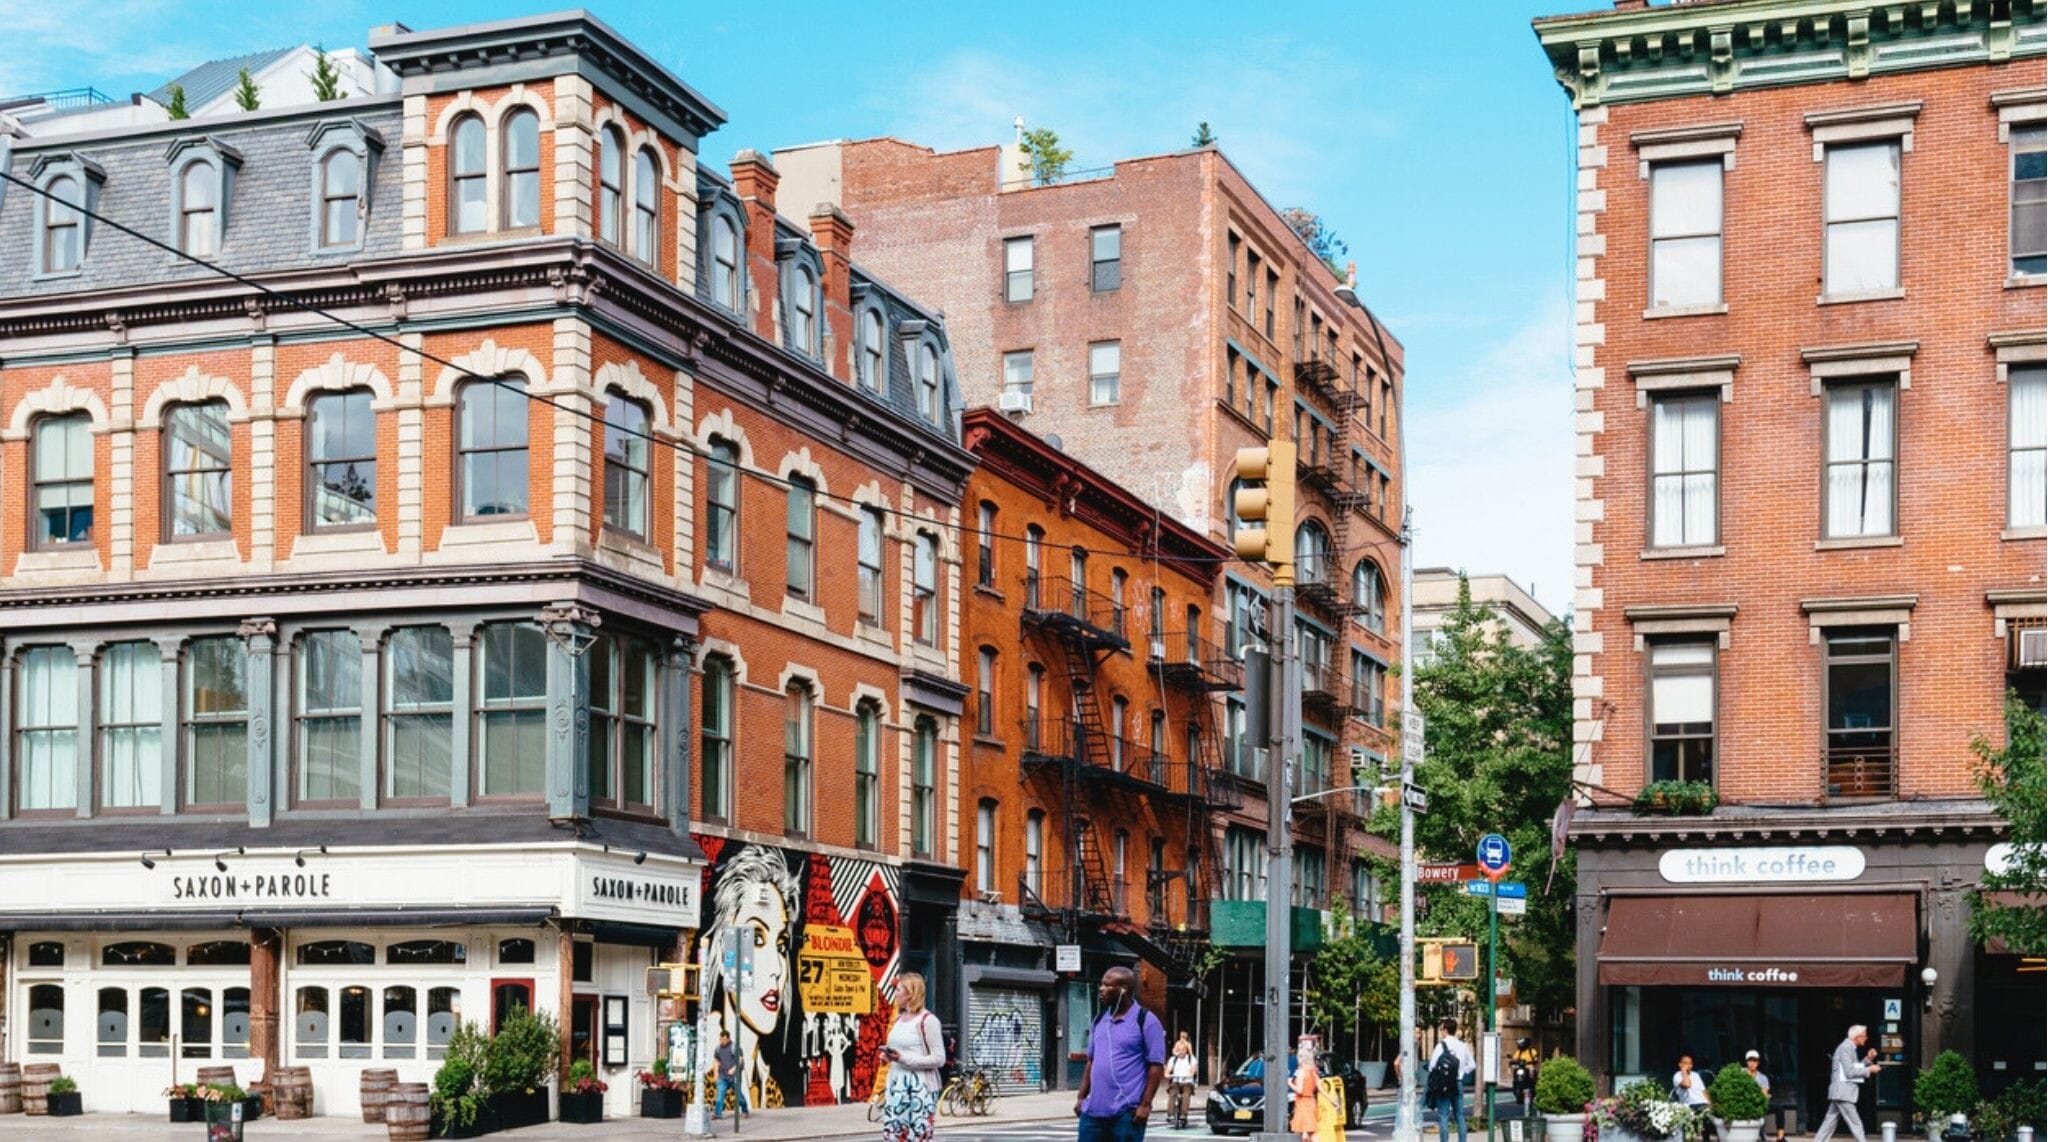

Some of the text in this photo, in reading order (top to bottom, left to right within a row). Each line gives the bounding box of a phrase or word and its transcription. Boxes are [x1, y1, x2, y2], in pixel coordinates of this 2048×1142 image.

[1418, 866, 1459, 881] Bowery
[1685, 854, 1836, 875] think coffee
[174, 873, 330, 899] SAXON+PAROLE
[593, 876, 689, 906] SAXON+PAROLE
[811, 935, 853, 953] BLONDIE
[800, 960, 824, 984] 27
[1708, 968, 1798, 982] think coffee
[1887, 1001, 1898, 1013] A
